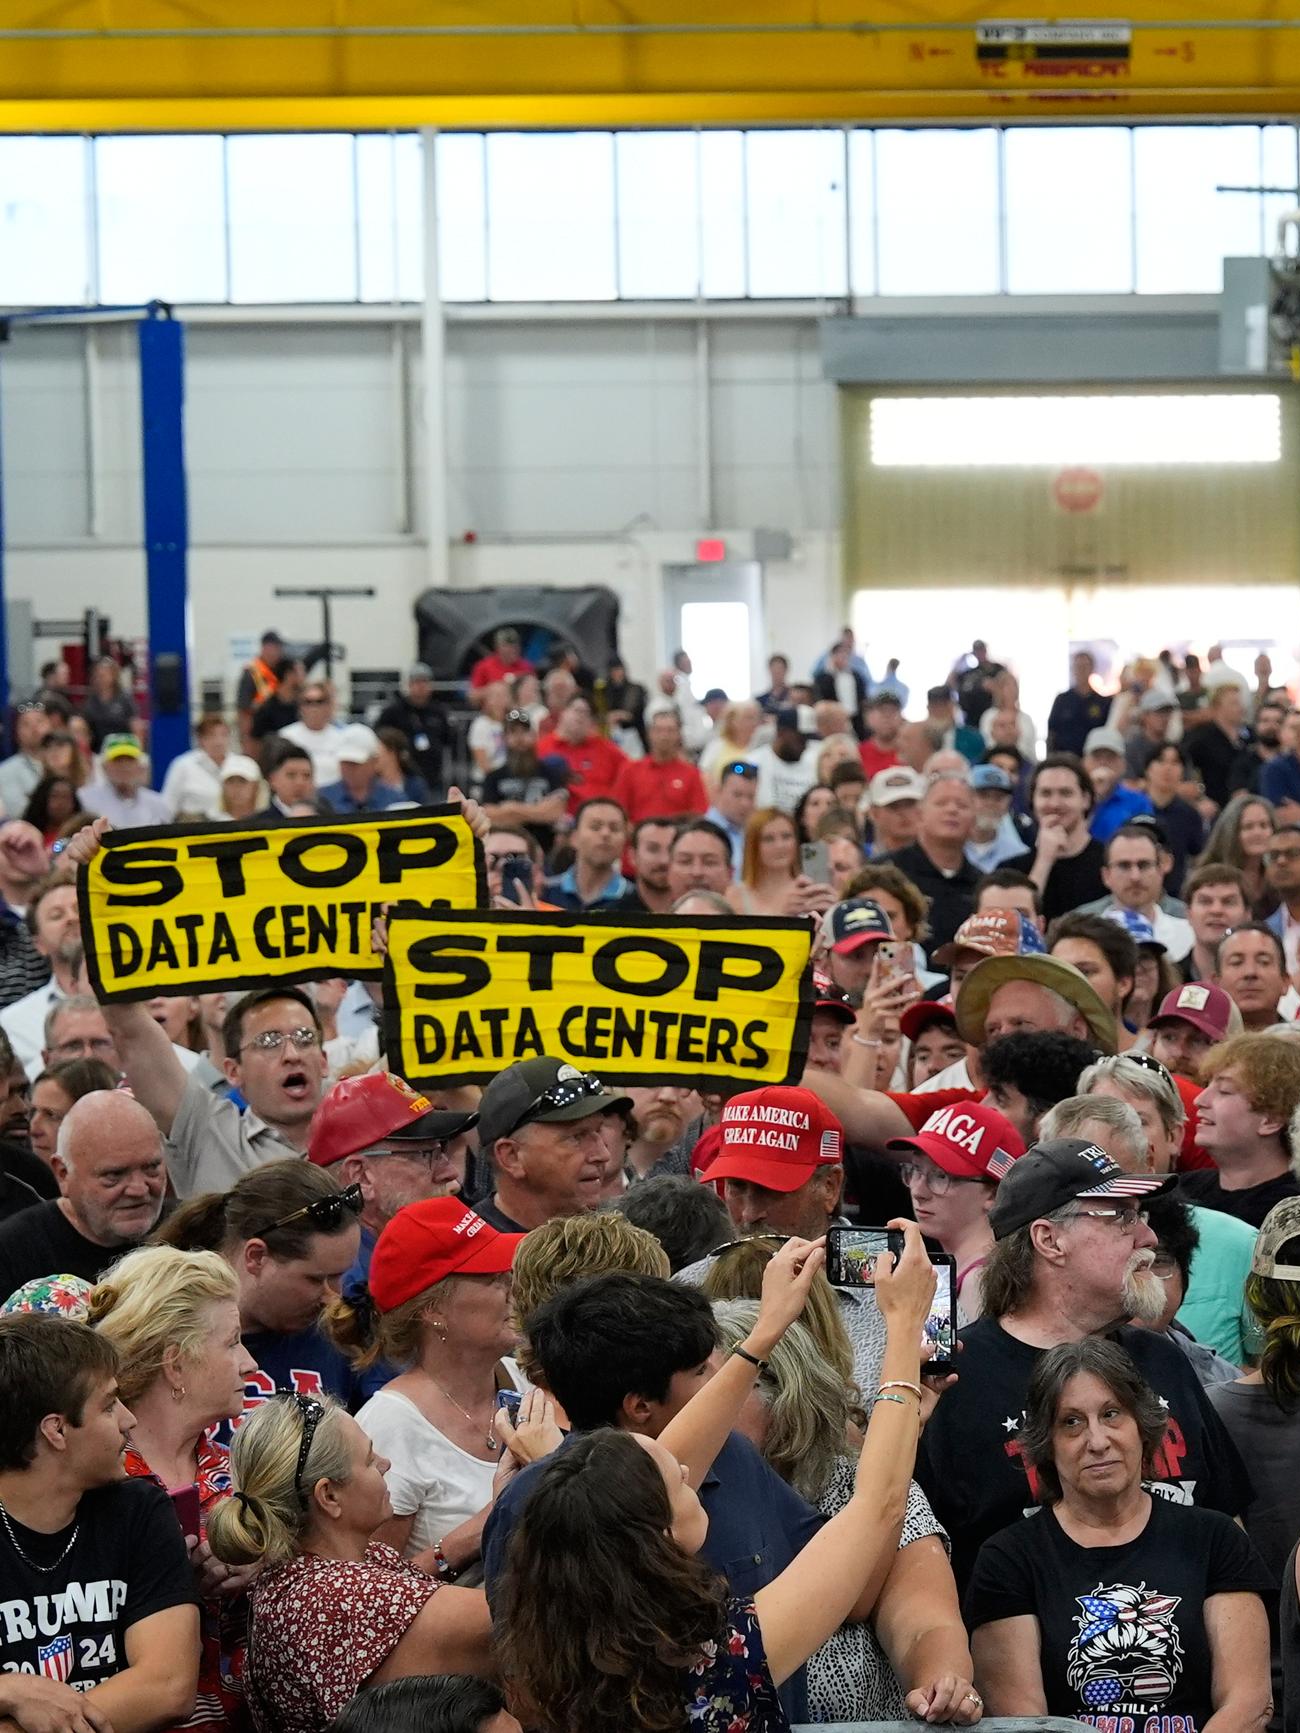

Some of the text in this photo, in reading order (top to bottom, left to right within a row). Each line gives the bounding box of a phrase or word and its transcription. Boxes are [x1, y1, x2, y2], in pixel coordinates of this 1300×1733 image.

[100, 823, 458, 907] STOP
[107, 898, 451, 979] DATA CENT
[407, 934, 785, 1001] STOP
[414, 1005, 769, 1069] DATA CENTERS
[722, 1105, 810, 1131] MAKE AMERICA
[724, 1127, 800, 1151] GREAT AGAIN
[1078, 1144, 1107, 1162] TRU
[1111, 1702, 1149, 1715] STILL
[1149, 1703, 1159, 1713] A
[1144, 1715, 1198, 1733] GIRL
